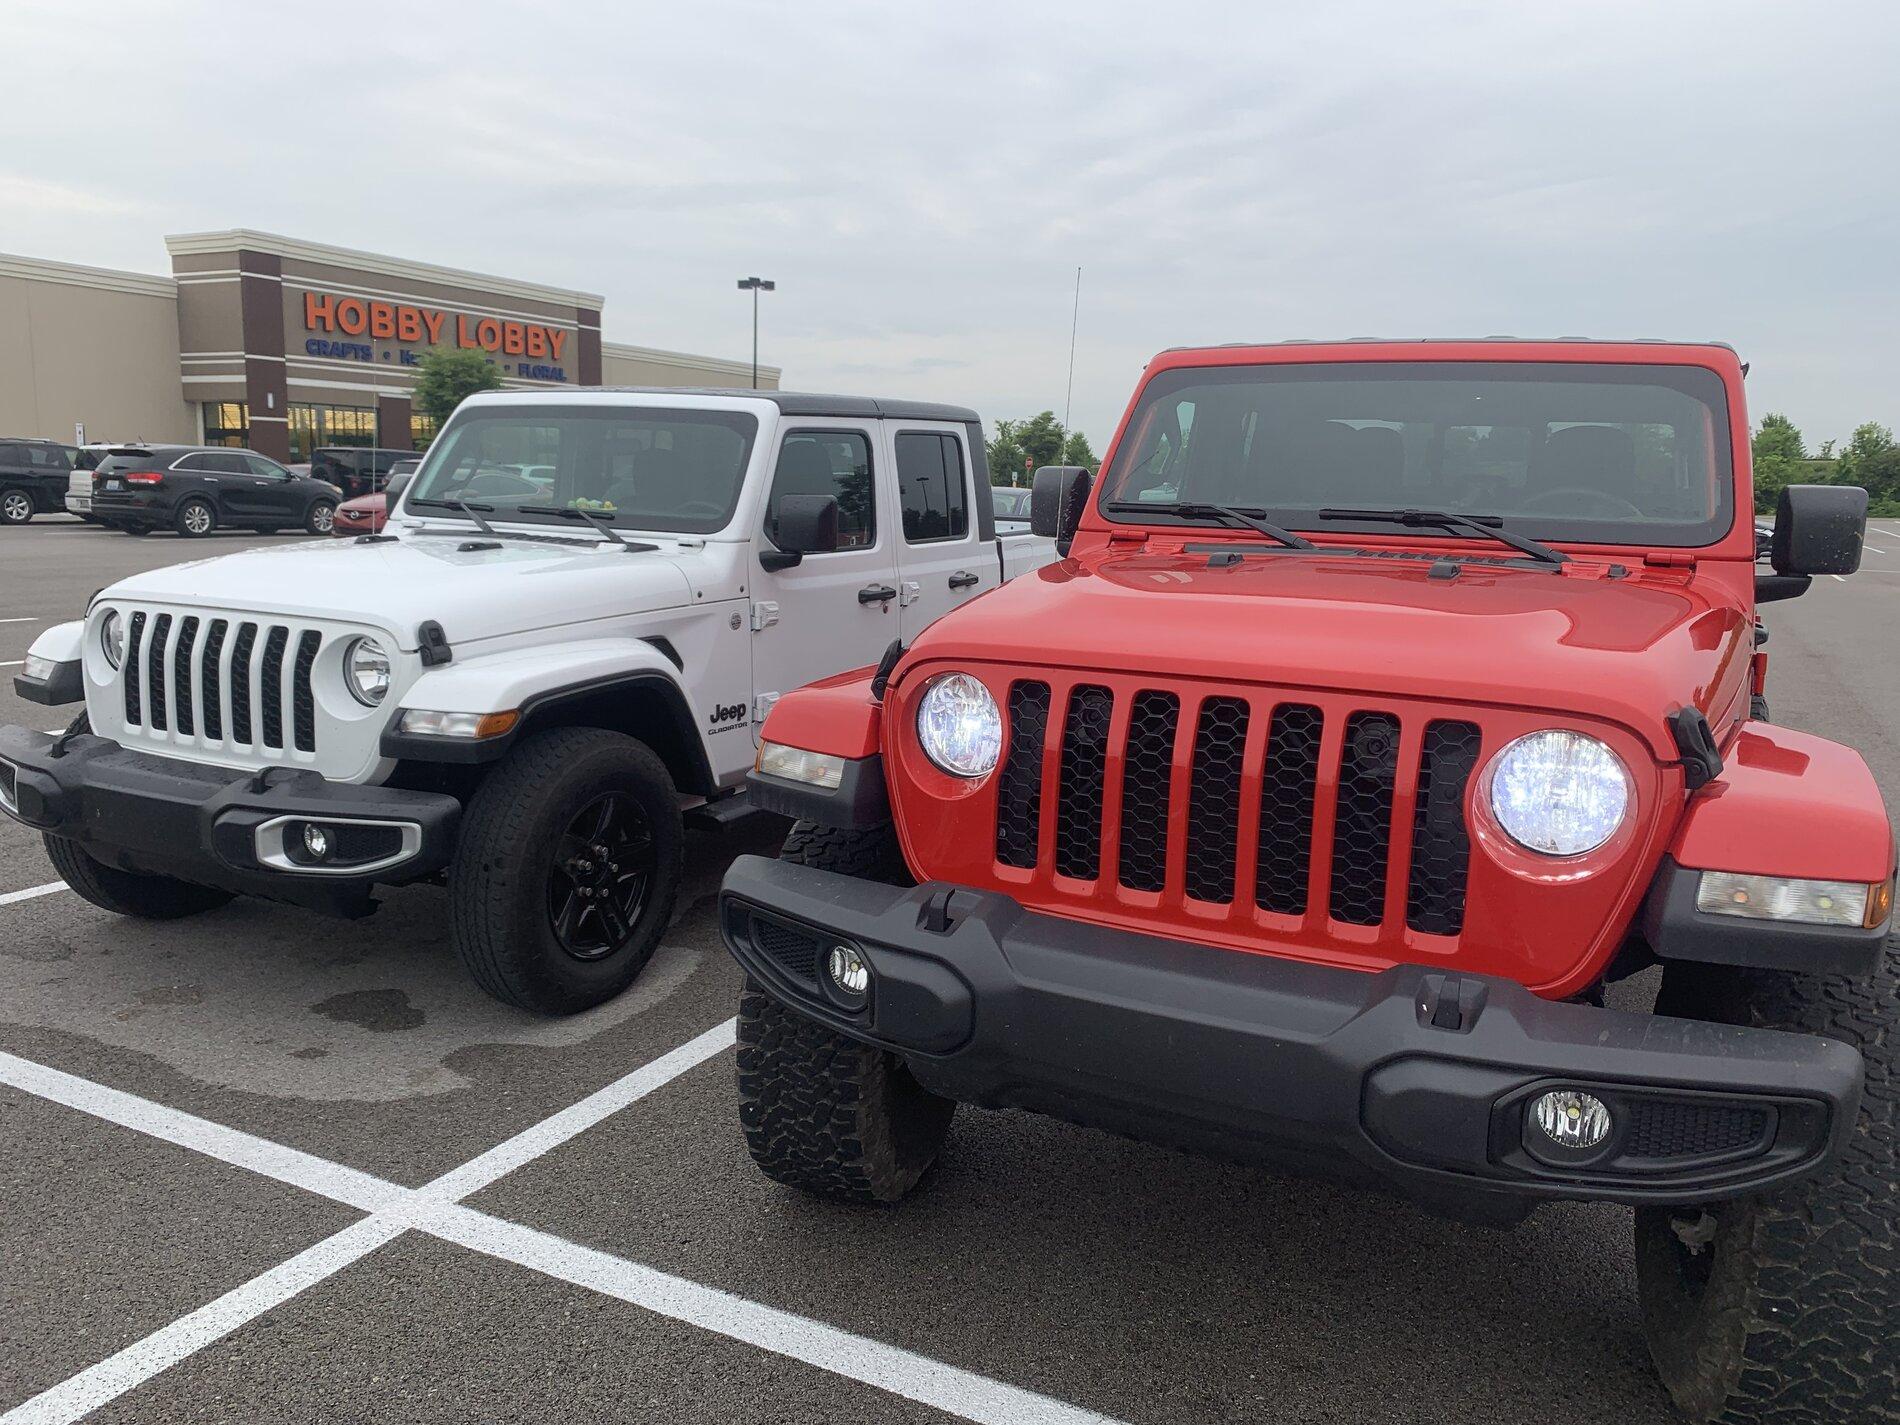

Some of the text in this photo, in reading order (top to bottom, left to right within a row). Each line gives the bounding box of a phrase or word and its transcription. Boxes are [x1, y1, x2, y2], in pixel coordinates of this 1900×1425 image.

[303, 291, 567, 361] HOBBY LOBBY
[306, 339, 567, 382] CRAFTS FLORAL
[708, 721, 748, 735] GLADIATOR
[710, 703, 746, 723] Jeep
